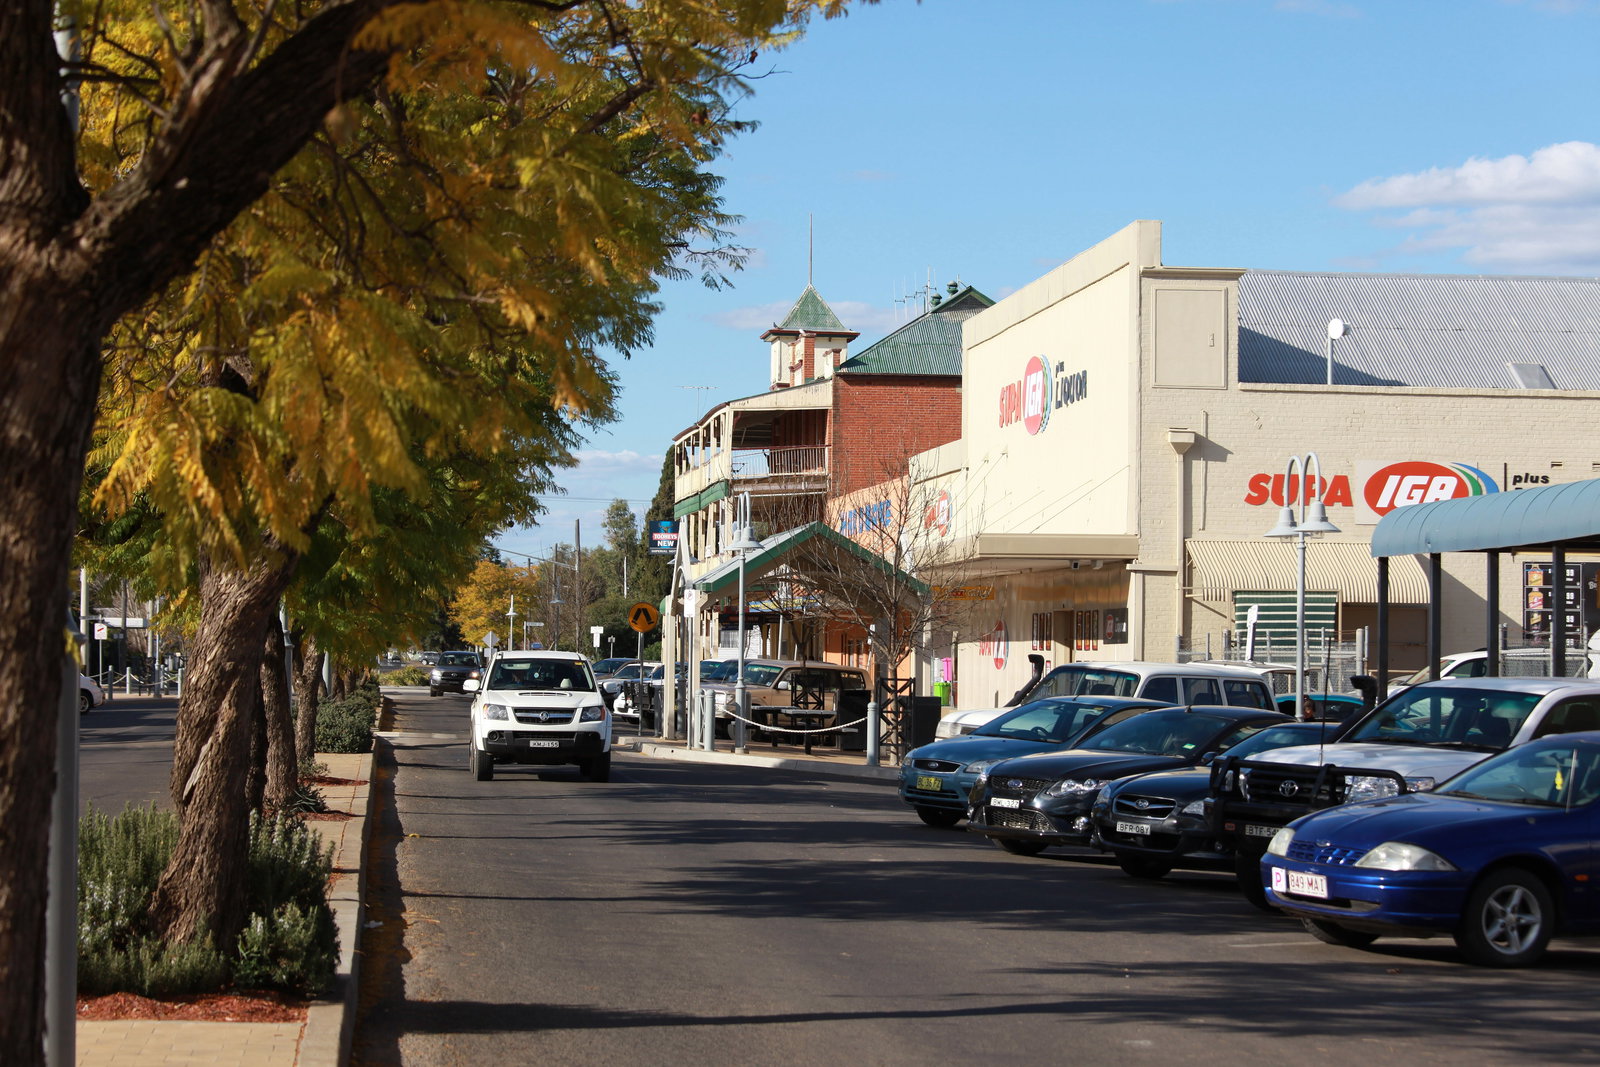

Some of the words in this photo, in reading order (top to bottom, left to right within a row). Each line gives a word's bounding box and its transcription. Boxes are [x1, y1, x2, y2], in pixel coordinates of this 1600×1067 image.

[999, 380, 1021, 428] SUPA
[1024, 370, 1043, 418] IGA
[1244, 473, 1353, 507] SUPA
[1375, 474, 1458, 508] IGA
[1512, 472, 1550, 486] plus
[1275, 871, 1281, 886] P
